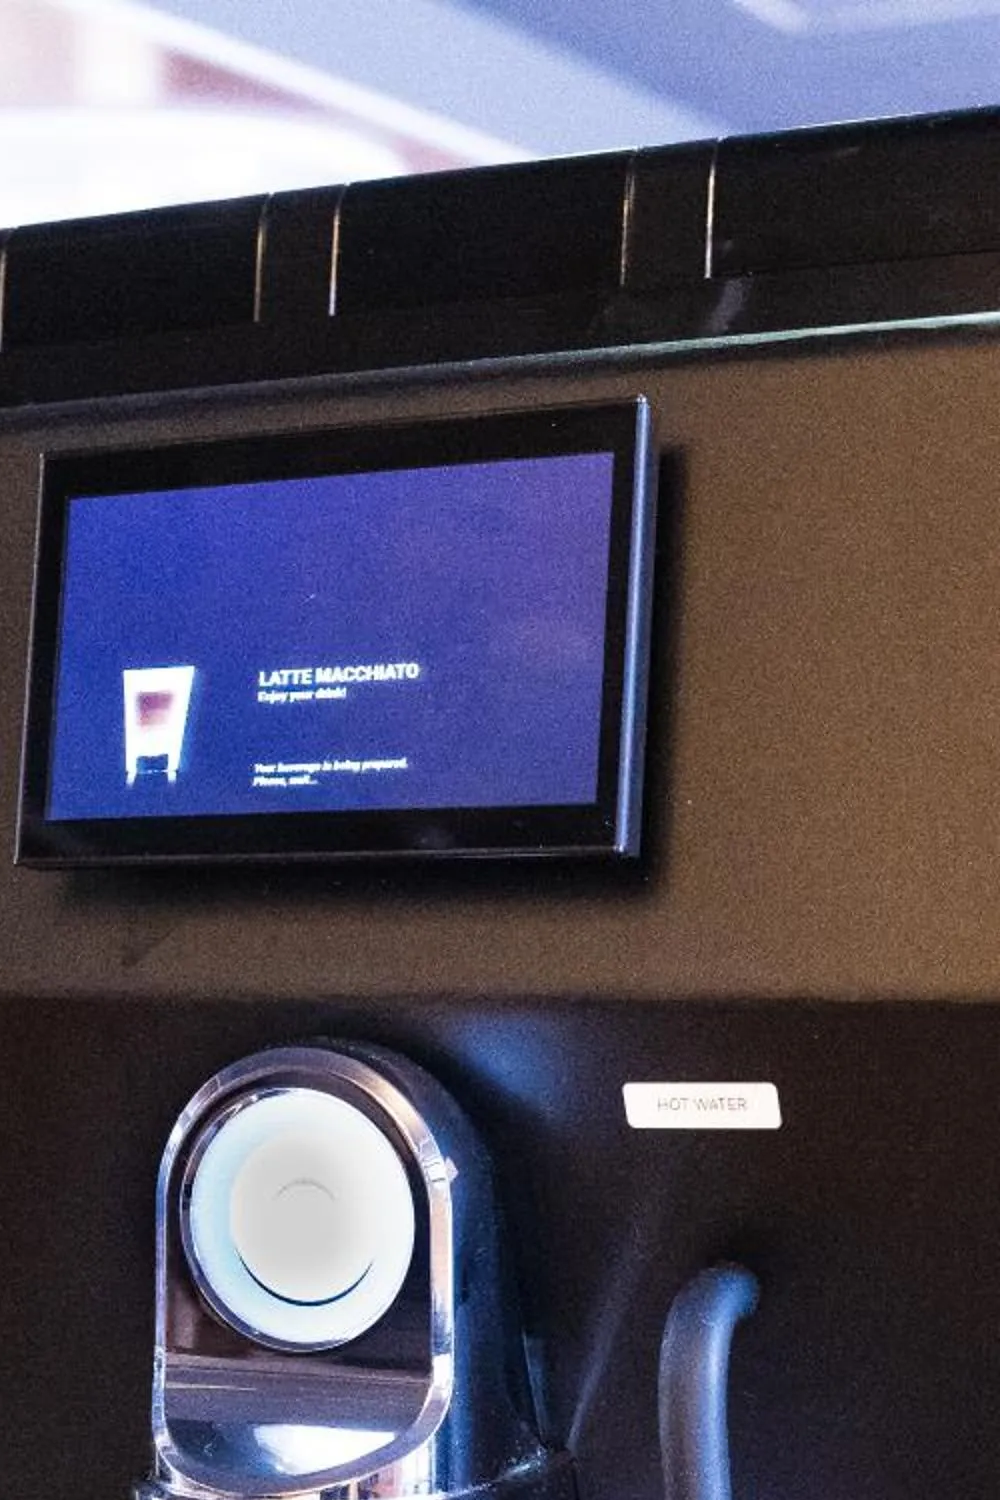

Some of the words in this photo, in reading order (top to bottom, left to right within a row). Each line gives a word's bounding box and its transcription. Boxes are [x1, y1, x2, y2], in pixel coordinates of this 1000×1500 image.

[259, 669, 312, 686] LATTE
[315, 663, 419, 682] MACCHIATO
[257, 691, 288, 703] Enjoy
[657, 1097, 689, 1112] HOT
[695, 1097, 748, 1112] WATER
